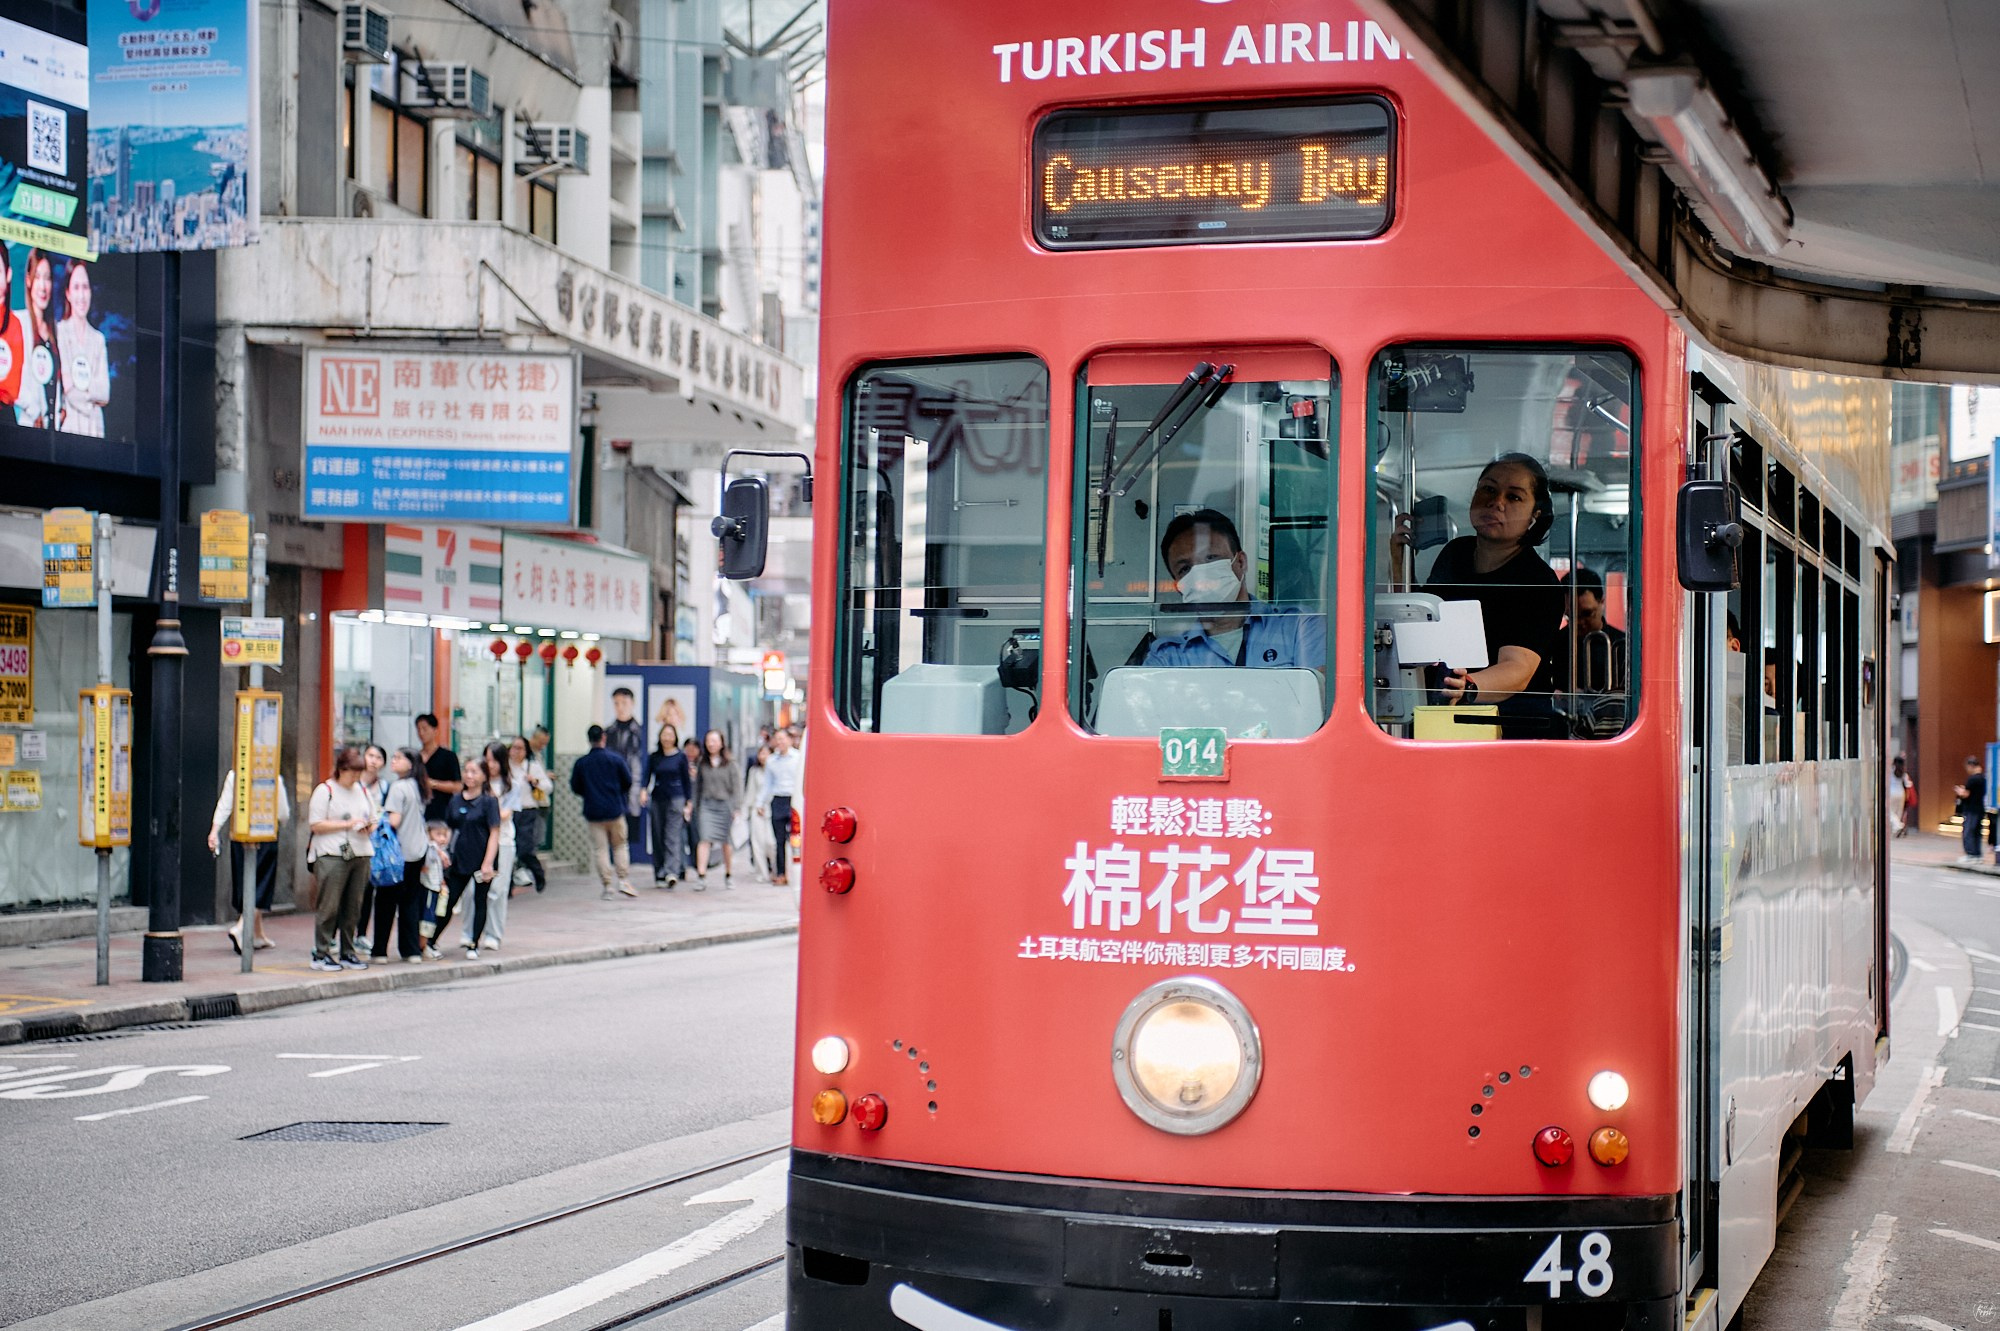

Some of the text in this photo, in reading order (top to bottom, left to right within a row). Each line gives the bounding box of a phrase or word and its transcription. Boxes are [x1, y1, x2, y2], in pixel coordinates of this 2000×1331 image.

[993, 20, 1415, 83] TURKISH AIRLIN
[1043, 144, 1388, 213] Causeway Bay
[322, 361, 379, 415] NE
[319, 425, 348, 436] NAN
[351, 426, 383, 439] HWA
[387, 427, 458, 440] (EXPRESS)
[393, 401, 559, 422] 旅行社有限公司
[0, 648, 27, 673] 3498
[1165, 737, 1219, 765] 014
[1062, 841, 1321, 936] 棉花堡
[1017, 936, 1356, 973] 土耳其航空伴你飛到更多不同國度。
[1523, 1232, 1615, 1298] 48
